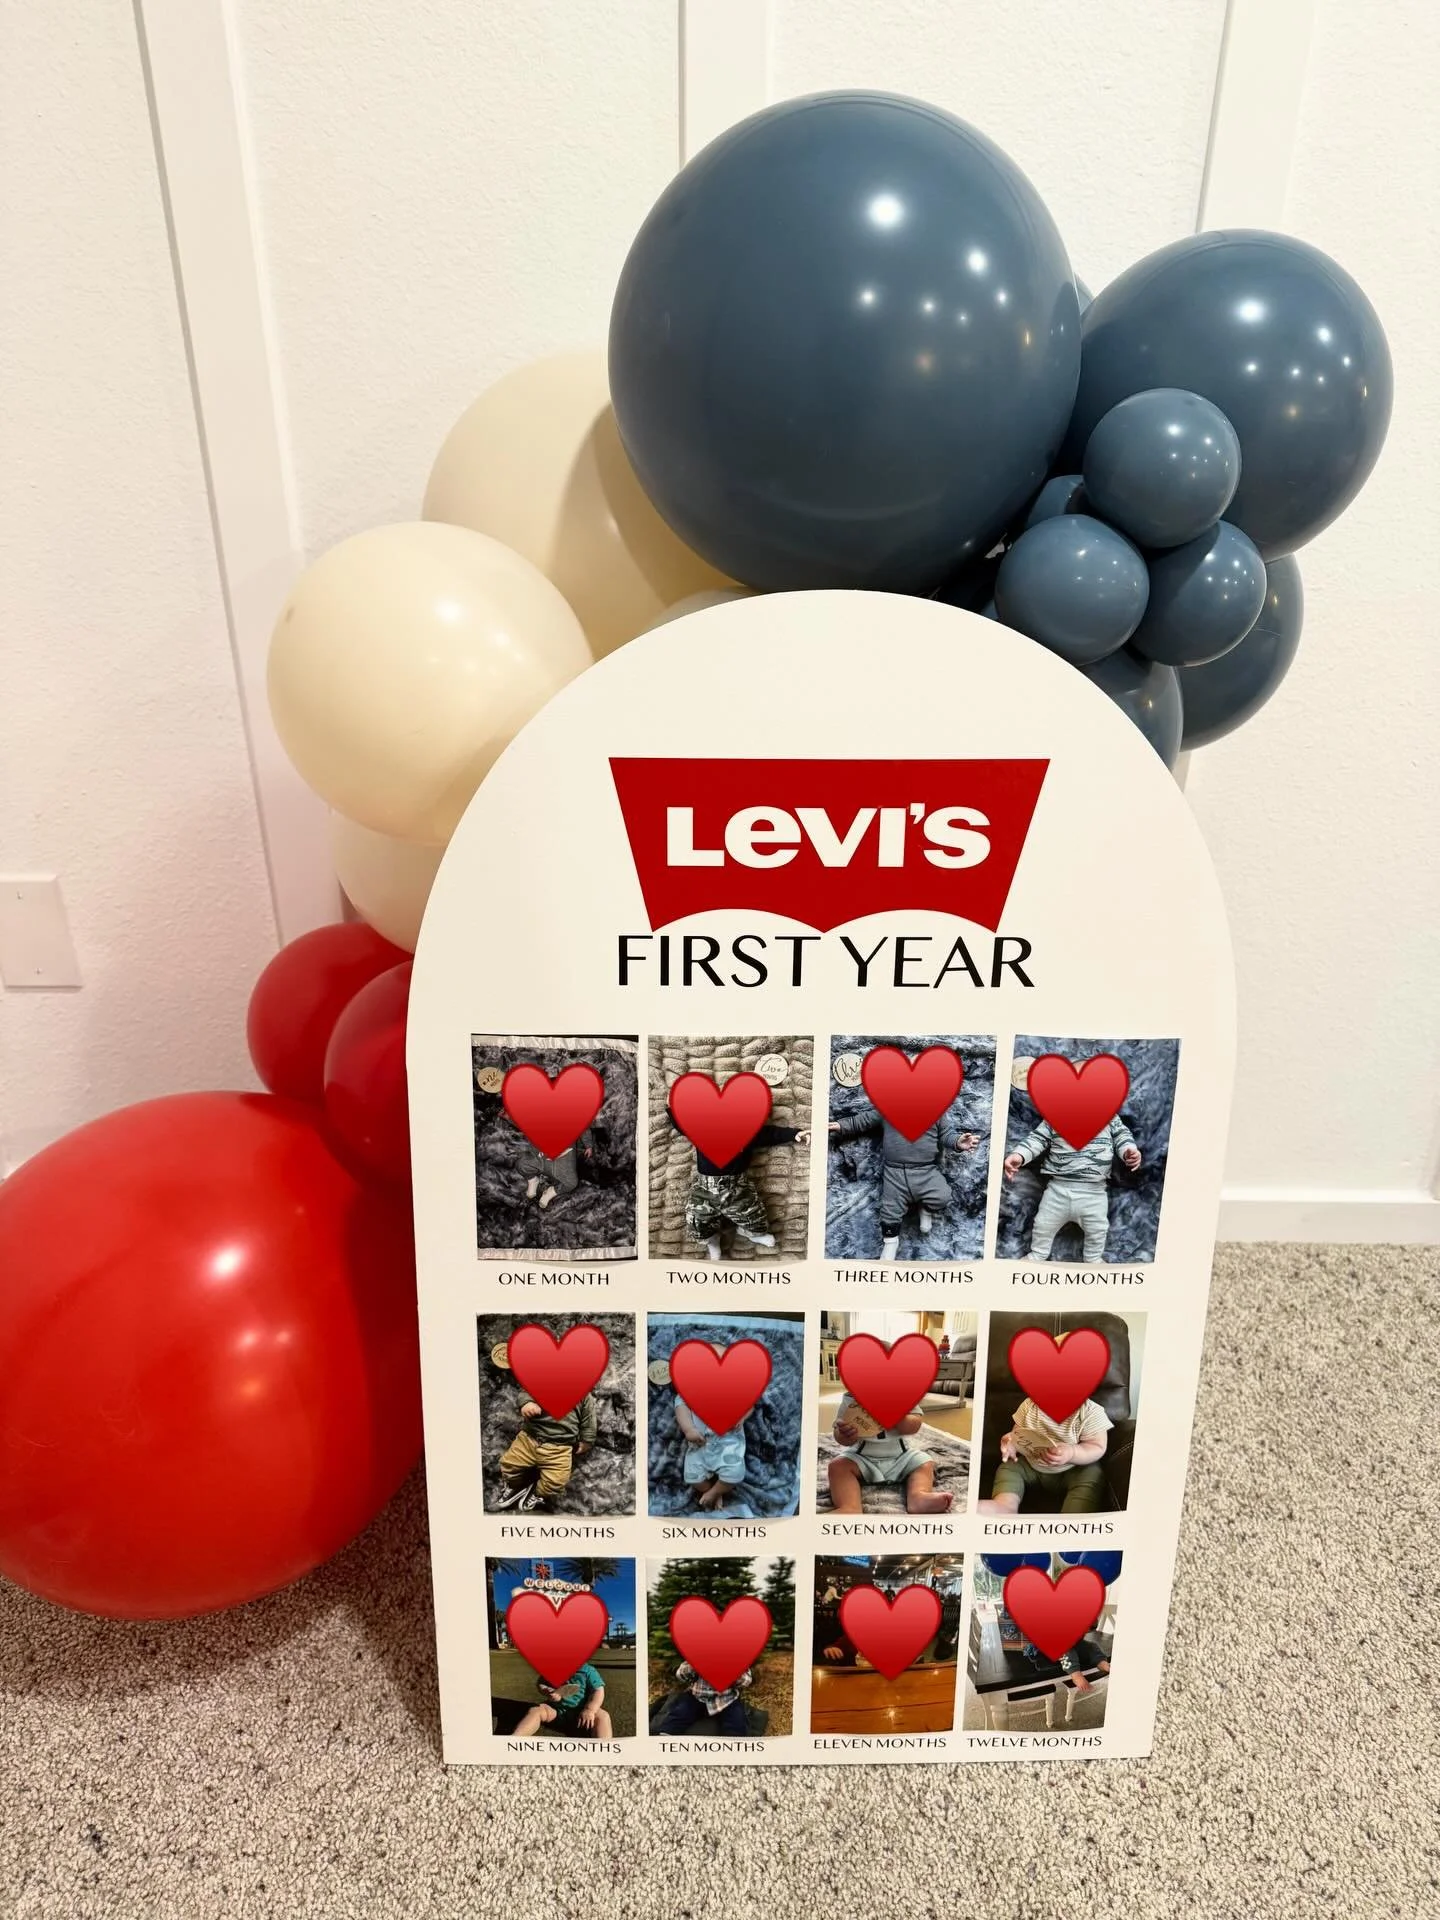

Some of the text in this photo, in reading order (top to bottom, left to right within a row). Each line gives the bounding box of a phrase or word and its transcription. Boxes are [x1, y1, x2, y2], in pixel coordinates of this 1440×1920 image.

[618, 934, 1036, 989] FIRST YEAR
[498, 1272, 610, 1286] ONE MONTH
[665, 1271, 791, 1285] TWO MONTHS
[833, 1269, 974, 1284] THREE MONTHS
[1011, 1271, 1145, 1286] FOUR MONTHS
[501, 1526, 615, 1539] FIVE MONTHS
[662, 1526, 767, 1540] SIX MONTHS
[821, 1523, 954, 1536] SEVEN MONTHS
[983, 1522, 1114, 1536] EIGHT MONTHS
[525, 1578, 590, 1591] WELCOME
[507, 1741, 622, 1754] NINE MONTHS
[659, 1740, 765, 1753] TEN MONTHS
[813, 1737, 947, 1750] ELEVEN MONTHS
[967, 1735, 1103, 1748] TWELVE MONTHS
